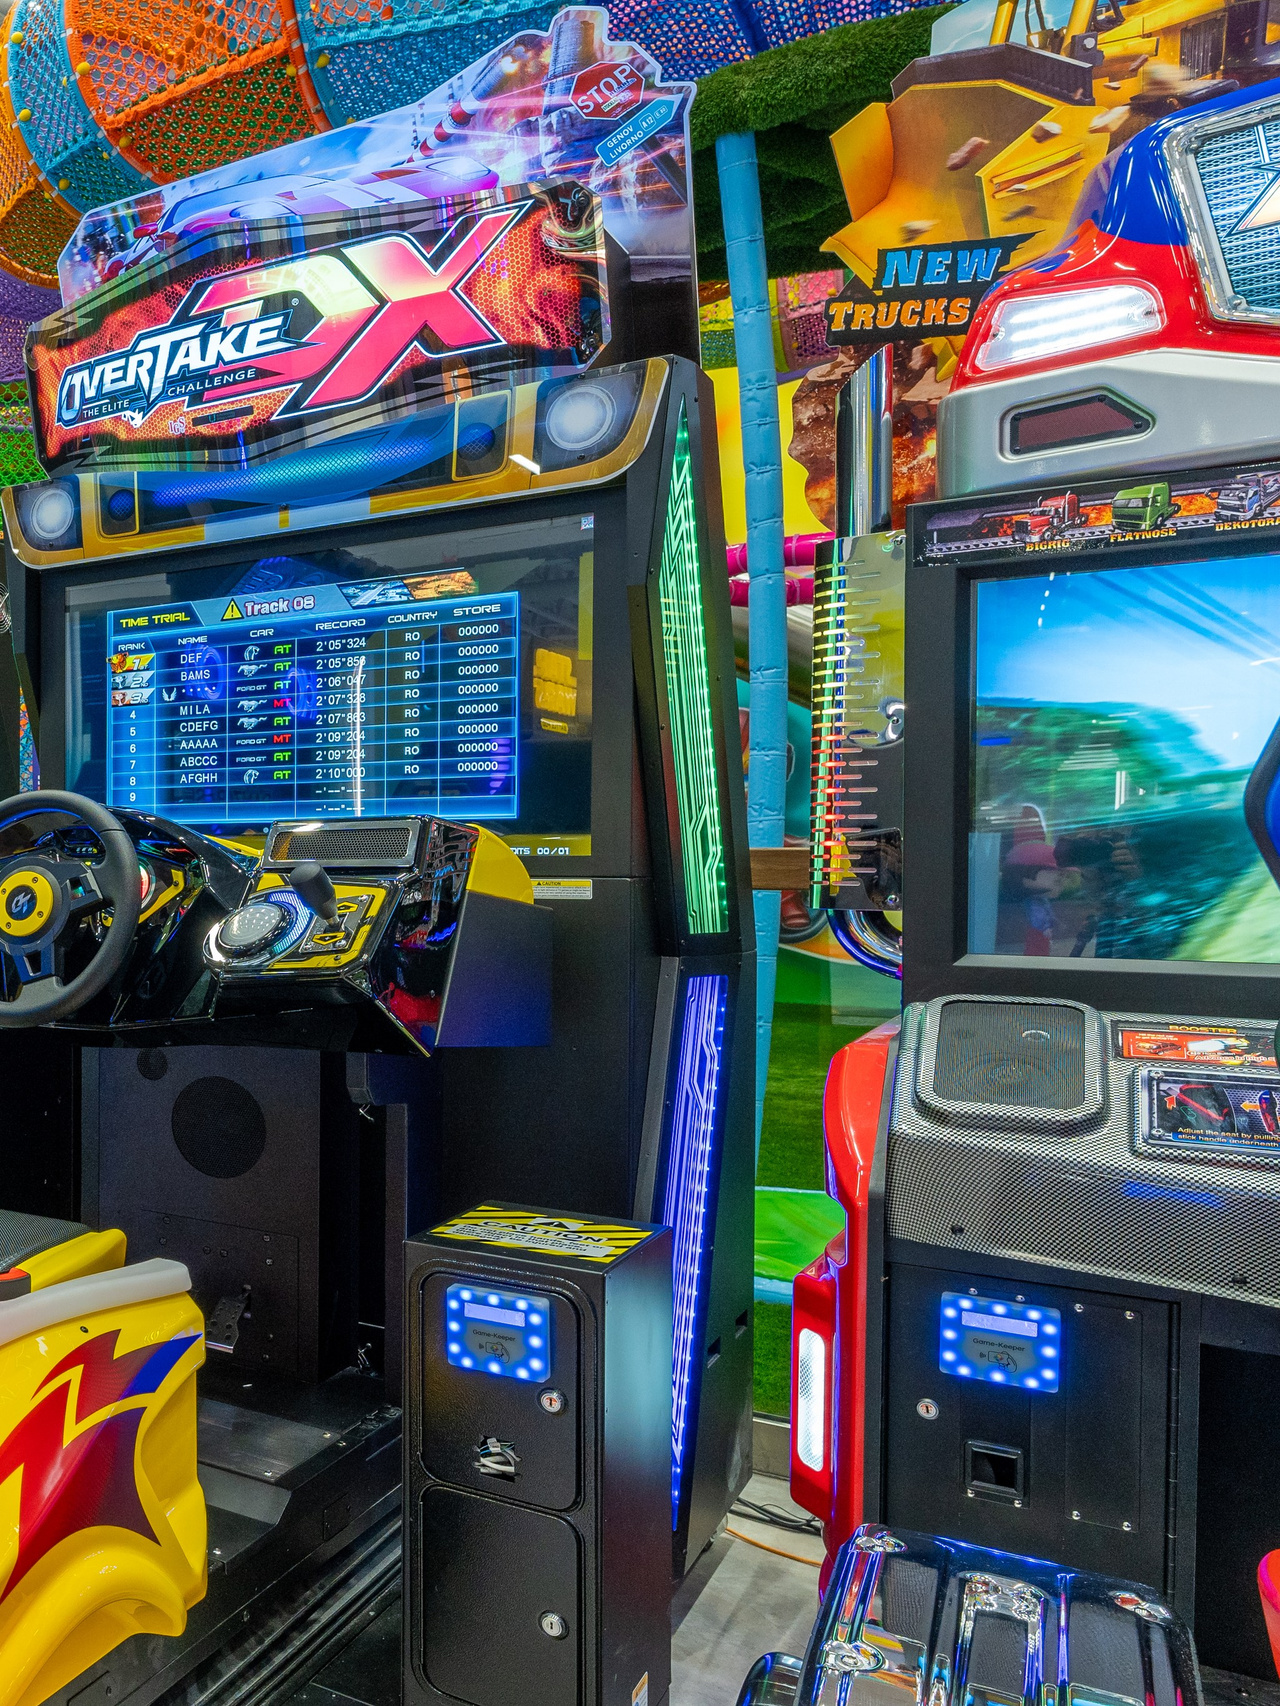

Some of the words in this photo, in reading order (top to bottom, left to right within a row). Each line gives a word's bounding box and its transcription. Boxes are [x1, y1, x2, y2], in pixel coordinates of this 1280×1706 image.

[577, 65, 631, 113] STOP
[607, 125, 634, 148] GENOV
[609, 130, 643, 159] LIVORNO
[882, 247, 1002, 289] NEW
[829, 298, 971, 331] TRUCKS
[60, 311, 296, 423] OVERTAKE
[167, 368, 257, 397] CHALLENGE
[83, 408, 100, 418] THE
[102, 399, 130, 413] ELITE
[169, 417, 186, 435] IGS
[1025, 539, 1070, 552] BIGRIG
[1109, 527, 1177, 543] FLATNOSE
[245, 598, 289, 616] Track
[293, 595, 315, 611] 08
[118, 642, 145, 651] RANK
[178, 636, 208, 645] NAME
[249, 629, 274, 638] CAR
[315, 618, 366, 631] RECORD
[387, 610, 438, 624] COUNTRY
[453, 604, 501, 617] STORE
[120, 616, 149, 628] TIME
[152, 612, 190, 625] TRIAL
[181, 653, 202, 664] DEF
[274, 644, 292, 655] AT
[316, 637, 366, 652] 2'05"324
[405, 632, 420, 642] RO
[458, 624, 499, 636] 000000
[181, 670, 211, 681] BAMS
[274, 661, 292, 672] AT
[405, 651, 420, 661] RO
[458, 644, 499, 656] 000000
[274, 680, 292, 690] AT
[404, 670, 420, 680] RO
[458, 663, 499, 675] 000000
[129, 710, 136, 719] 4
[179, 704, 210, 716] MILA
[273, 699, 291, 708] MT
[404, 689, 419, 699] RO
[458, 683, 499, 695] 000000
[129, 727, 136, 736] 5
[179, 721, 218, 733] CDEFG
[273, 716, 291, 726] AT
[404, 708, 419, 718] RO
[458, 703, 499, 715] 000000
[129, 744, 136, 753] 6
[179, 738, 218, 750] AAAAA
[273, 734, 291, 743] MT
[404, 728, 419, 737] RO
[458, 723, 499, 734] 000000
[129, 760, 136, 770] 7
[179, 756, 218, 768] ABCCC
[273, 752, 291, 761] AT
[404, 746, 419, 755] RO
[458, 742, 499, 753] 000000
[129, 776, 136, 786] 8
[179, 772, 218, 784] AFGHH
[273, 770, 291, 780] AT
[404, 765, 419, 774] RO
[458, 761, 499, 772] 000000
[129, 793, 136, 802] 9
[537, 846, 571, 855] 00/01
[1169, 1025, 1237, 1034] BOOSTER
[1178, 1127, 1204, 1135] Adjust
[1198, 1135, 1227, 1143] handle
[483, 1221, 604, 1243] CAUTION
[472, 1329, 516, 1341] Game-Keeper
[973, 1338, 1025, 1352] Game-Keeper
